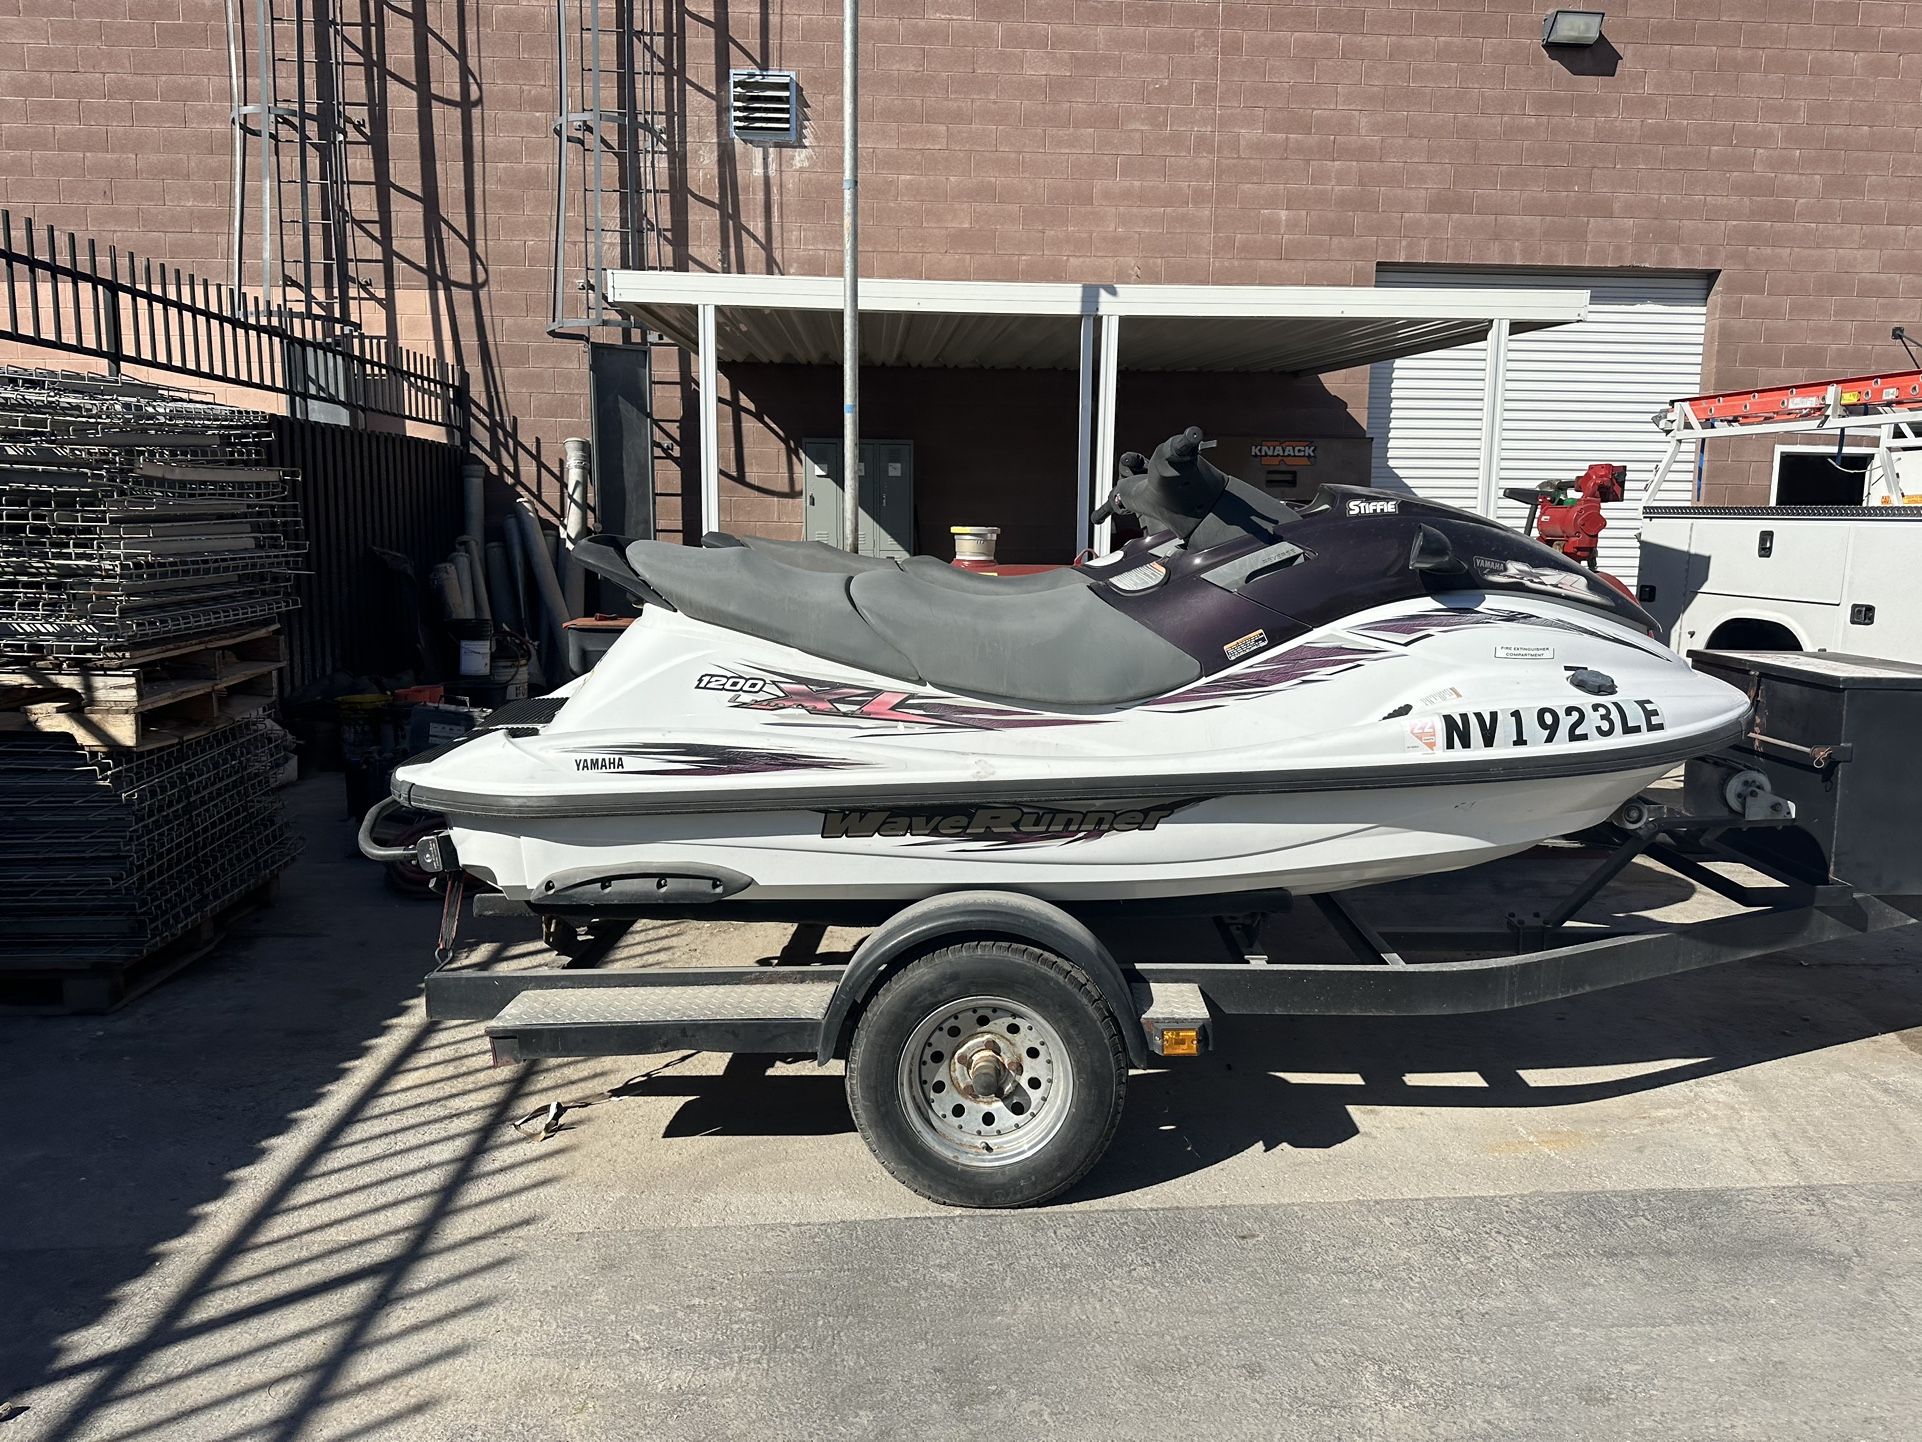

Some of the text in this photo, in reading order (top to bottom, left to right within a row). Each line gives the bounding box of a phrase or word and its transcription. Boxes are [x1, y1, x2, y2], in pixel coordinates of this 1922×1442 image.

[1251, 446, 1315, 456] KNAACK
[1348, 499, 1397, 515] STIFFIE
[1476, 559, 1504, 571] YAMAHA
[695, 674, 767, 693] 1200
[575, 757, 625, 771] YAMAHA
[821, 805, 1174, 839] WaveRunner
